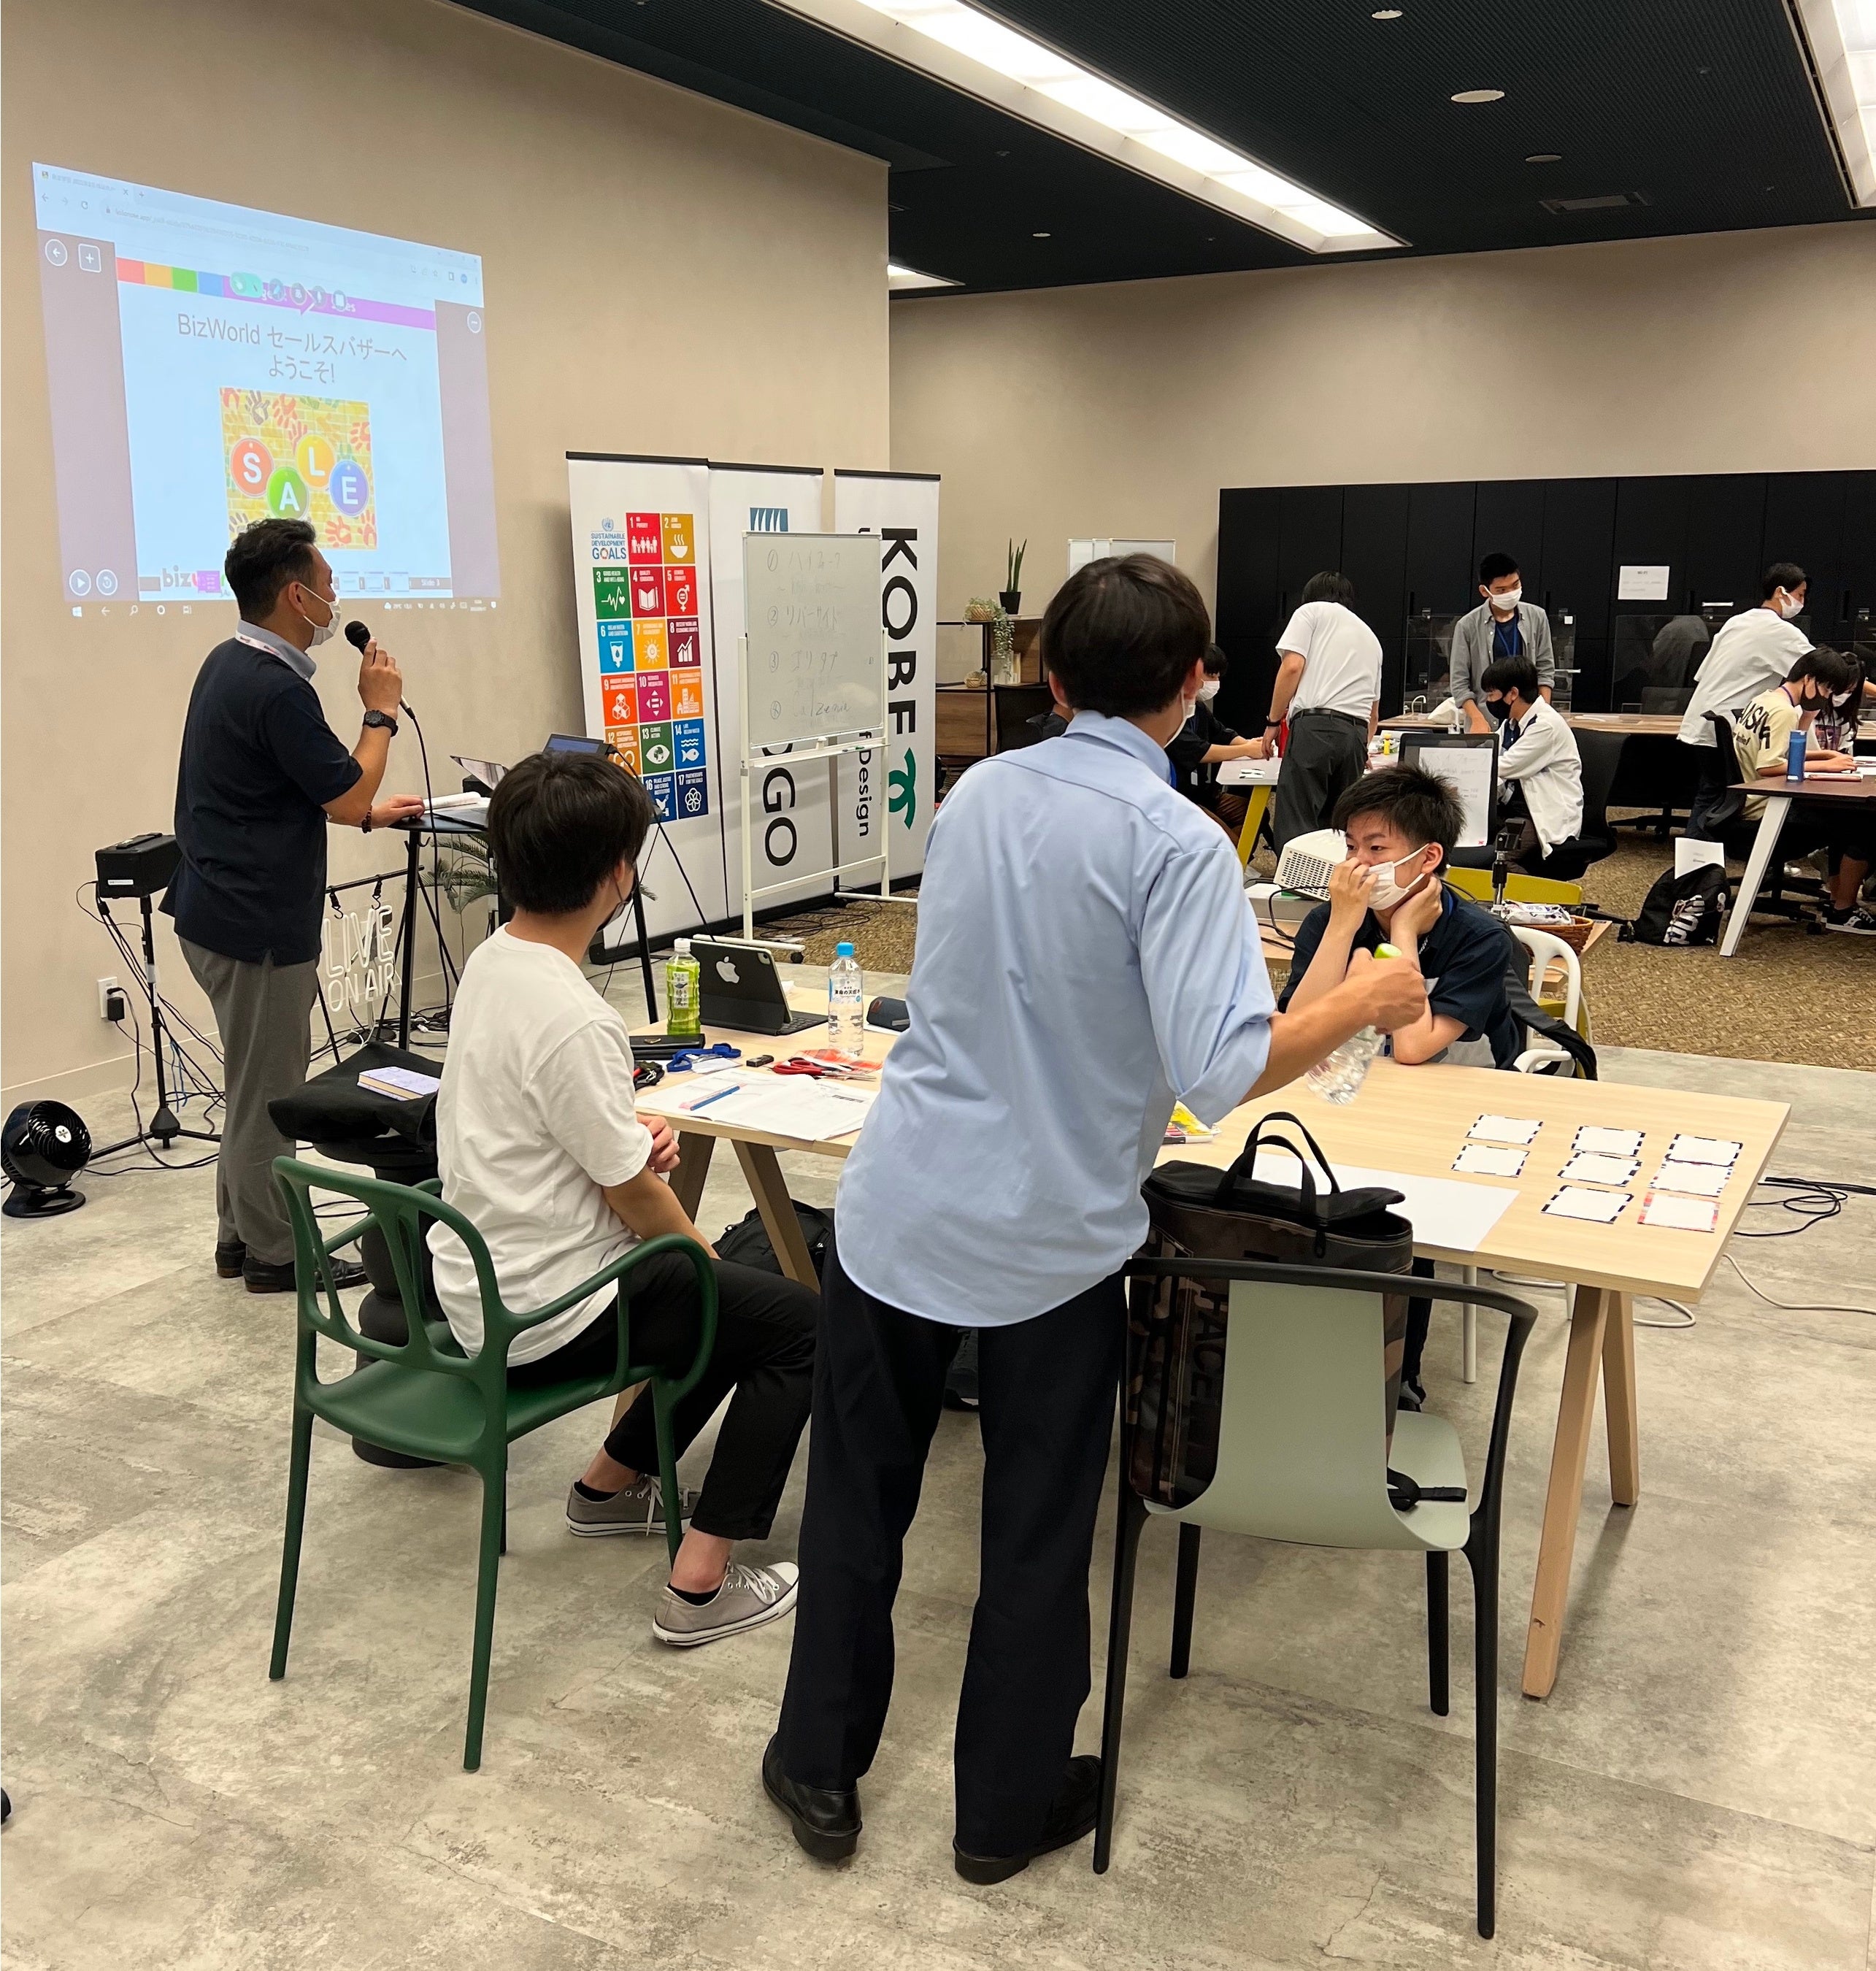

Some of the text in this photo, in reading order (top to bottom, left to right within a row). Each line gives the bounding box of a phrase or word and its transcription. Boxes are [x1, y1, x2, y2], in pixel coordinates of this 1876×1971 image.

[178, 313, 407, 361] BizWorld セールスバザーへ
[269, 354, 335, 384] ようこそ!
[243, 447, 359, 512] SALE
[629, 516, 634, 529] 1
[664, 517, 669, 529] 2
[592, 547, 627, 560] GOALS
[596, 571, 601, 583] 3
[633, 570, 638, 582] 4
[666, 570, 672, 581] 5
[601, 625, 606, 637] 6
[636, 623, 641, 635] 7
[669, 622, 675, 633] 8
[604, 679, 610, 691] 9
[639, 676, 647, 688] 10
[672, 674, 678, 685] 11
[642, 728, 650, 739] 13
[674, 724, 683, 736] 14
[608, 731, 615, 744] 12
[645, 779, 653, 791] 16
[678, 774, 685, 785] 17
[856, 750, 872, 837] Design
[323, 904, 394, 978] LIVE
[328, 963, 395, 1013] ON AIR
